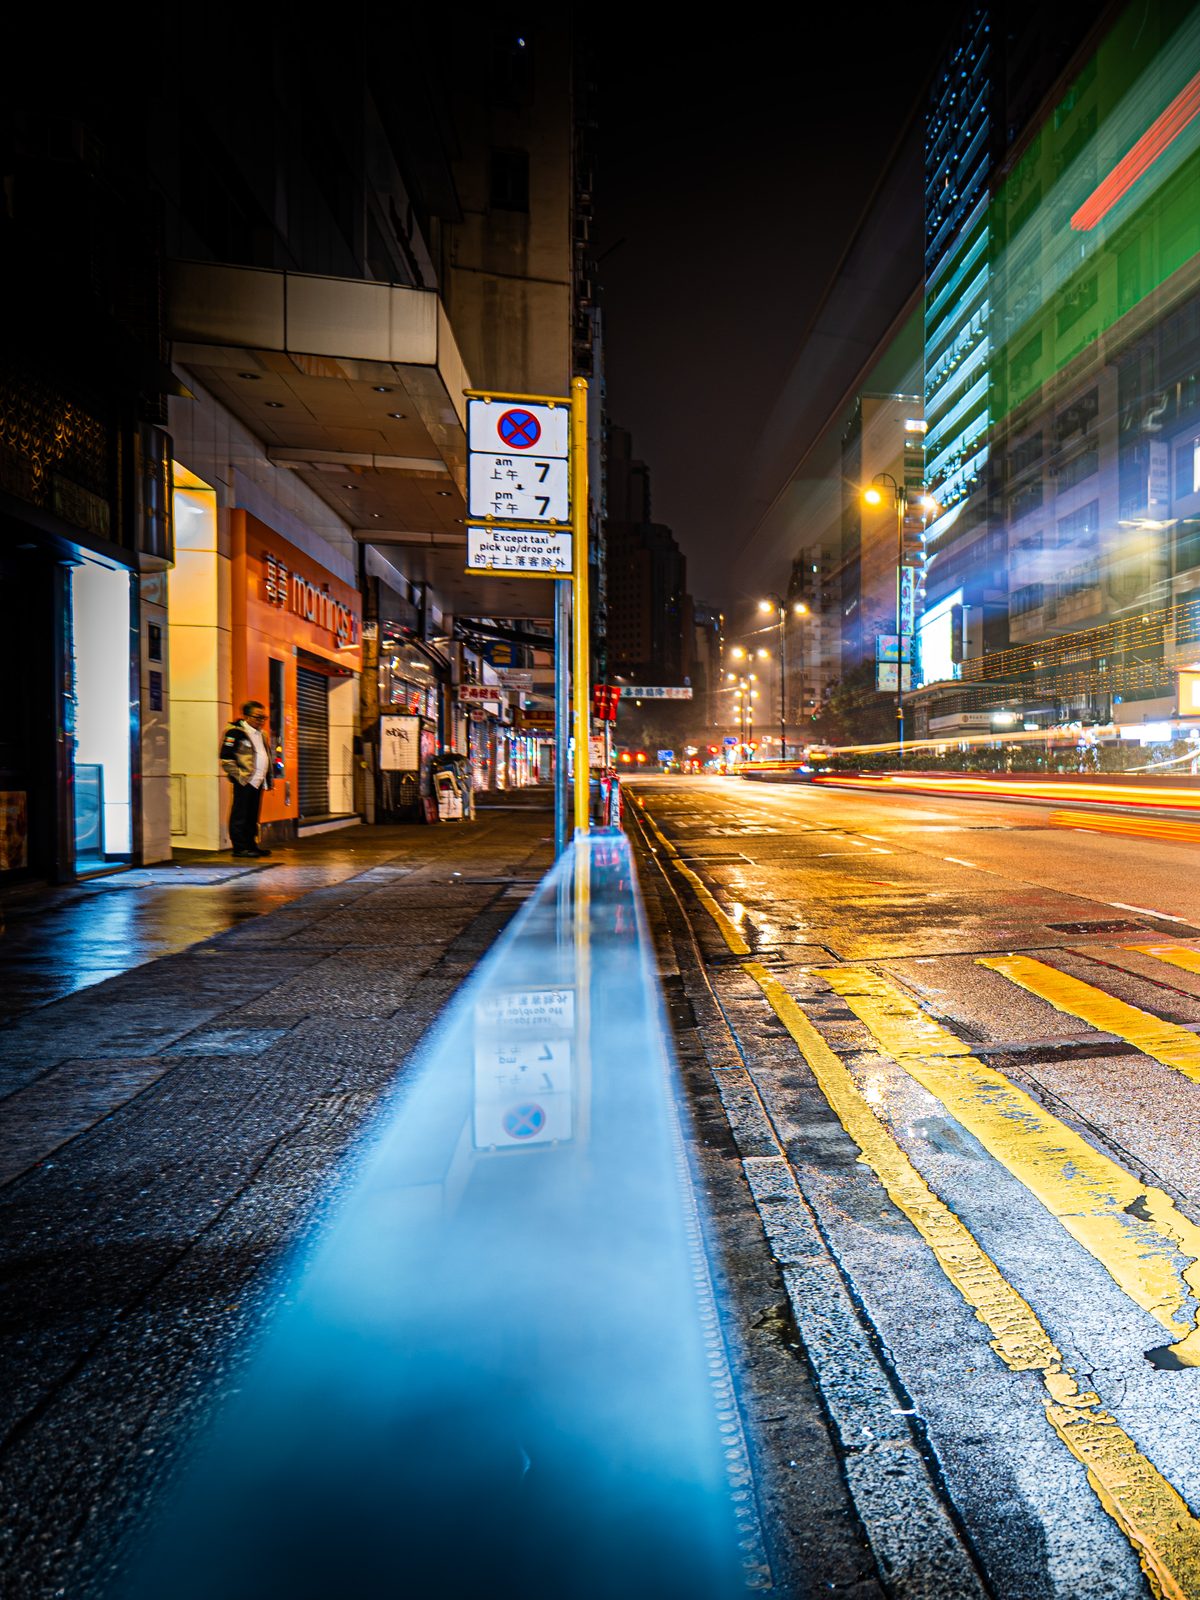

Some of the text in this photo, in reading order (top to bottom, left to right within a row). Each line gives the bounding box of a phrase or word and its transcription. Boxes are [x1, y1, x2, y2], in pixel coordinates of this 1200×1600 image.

[495, 458, 513, 467] am
[490, 468, 519, 481] 上午
[535, 462, 550, 484] 7
[495, 491, 513, 501] pm
[490, 501, 519, 515] 下午
[535, 495, 550, 516] 7
[492, 533, 549, 545] Except taxi
[480, 542, 561, 555] pick up/drop off
[474, 553, 566, 569] 的士上落客除外
[293, 572, 351, 648] mannings
